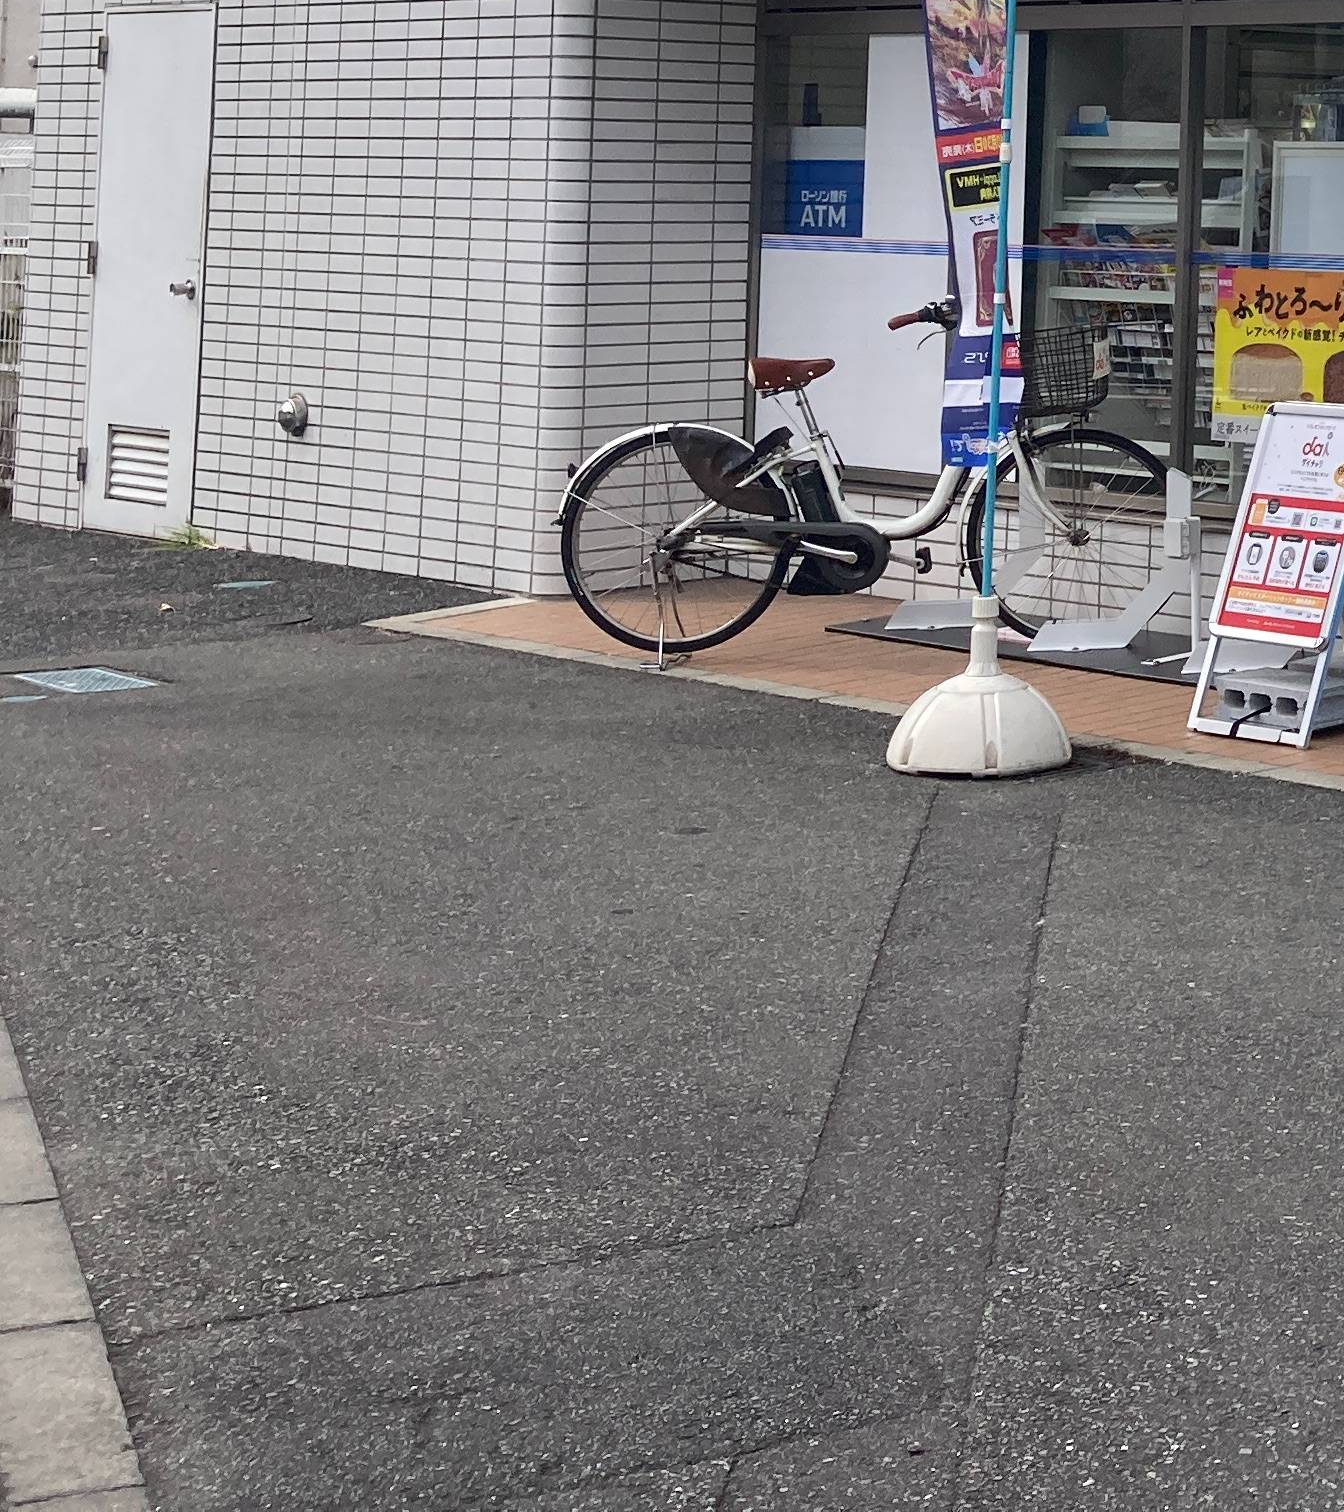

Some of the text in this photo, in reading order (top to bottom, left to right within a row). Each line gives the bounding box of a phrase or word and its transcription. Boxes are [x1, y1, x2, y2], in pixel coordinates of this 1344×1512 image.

[801, 190, 848, 203] ローソン銀行
[800, 204, 847, 228] ATM
